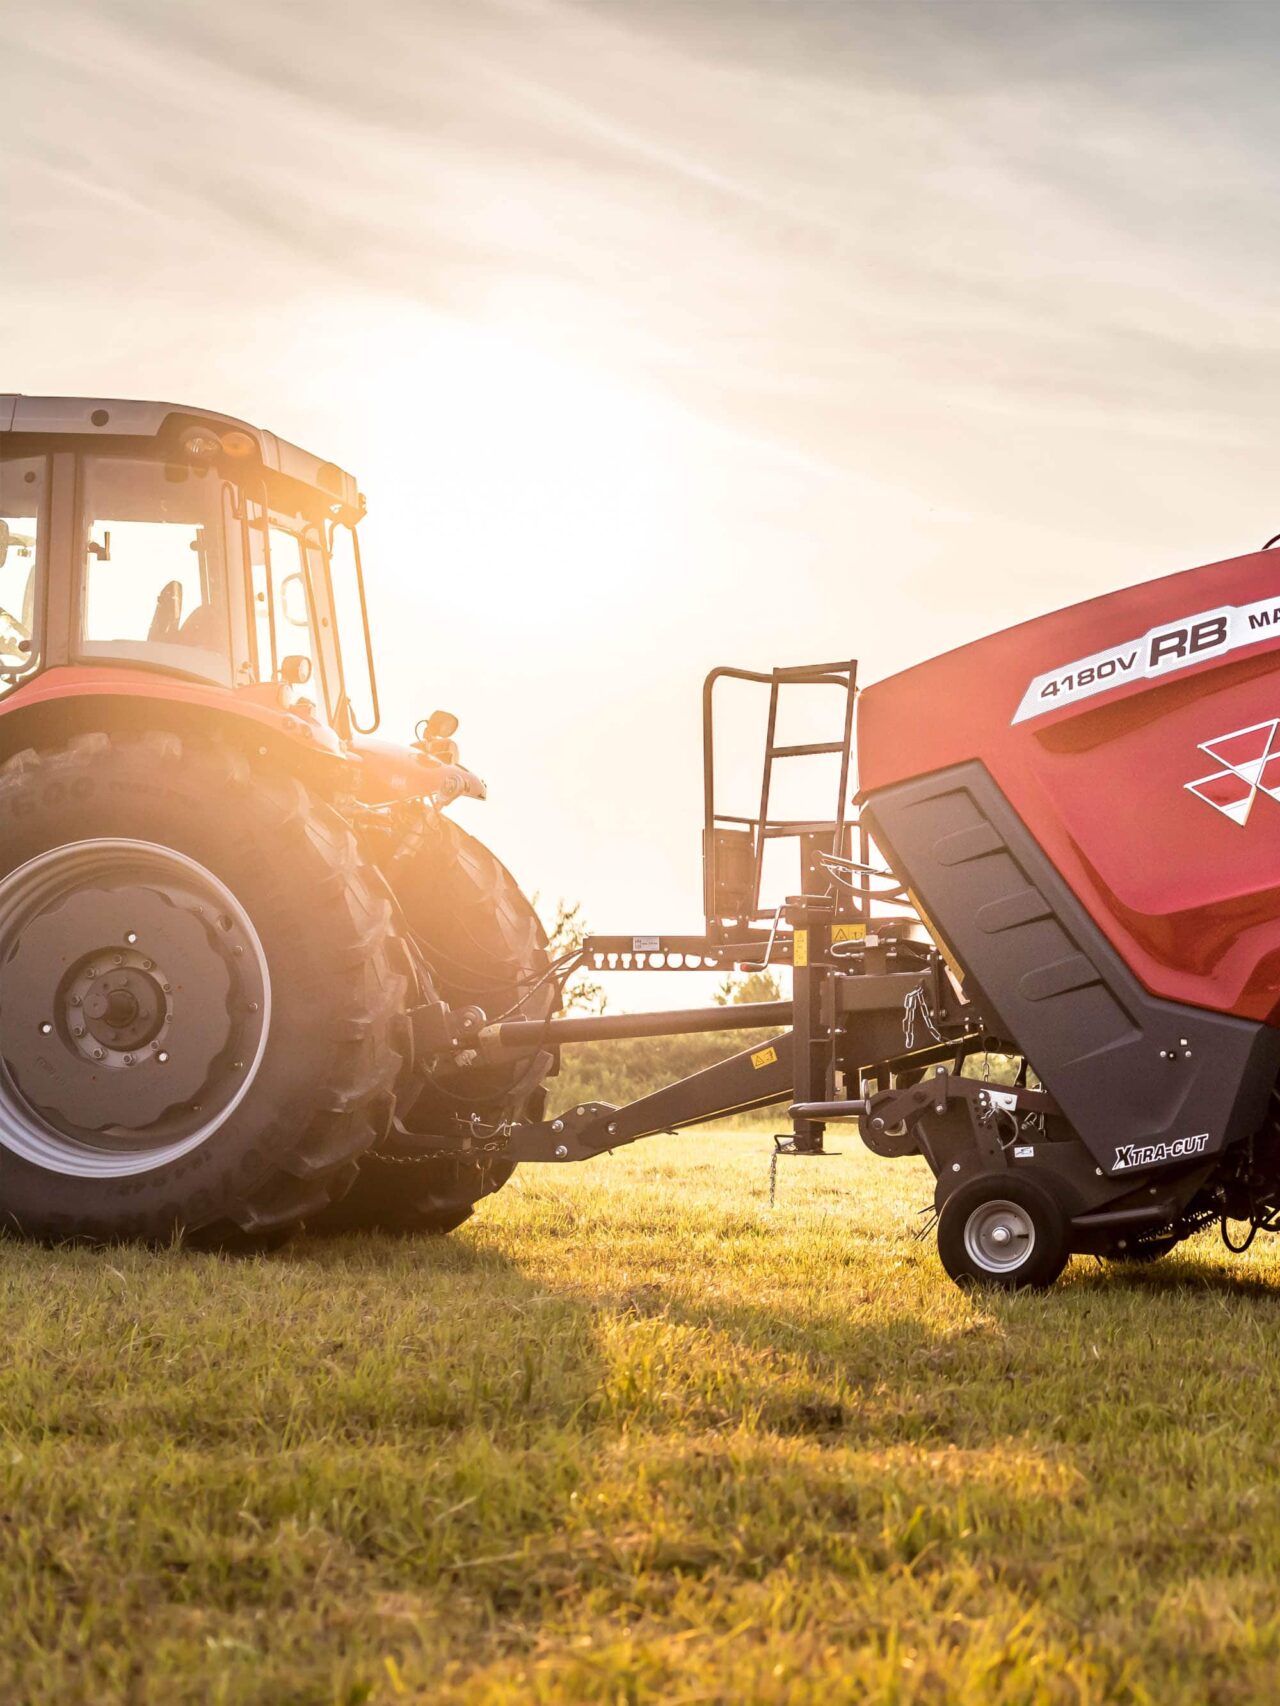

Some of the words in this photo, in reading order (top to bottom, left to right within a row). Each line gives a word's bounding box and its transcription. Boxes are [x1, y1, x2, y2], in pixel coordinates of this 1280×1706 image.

[1040, 651, 1138, 698] 4180V
[1149, 616, 1227, 668] RB
[1111, 1133, 1210, 1171] XTRA-CUT
